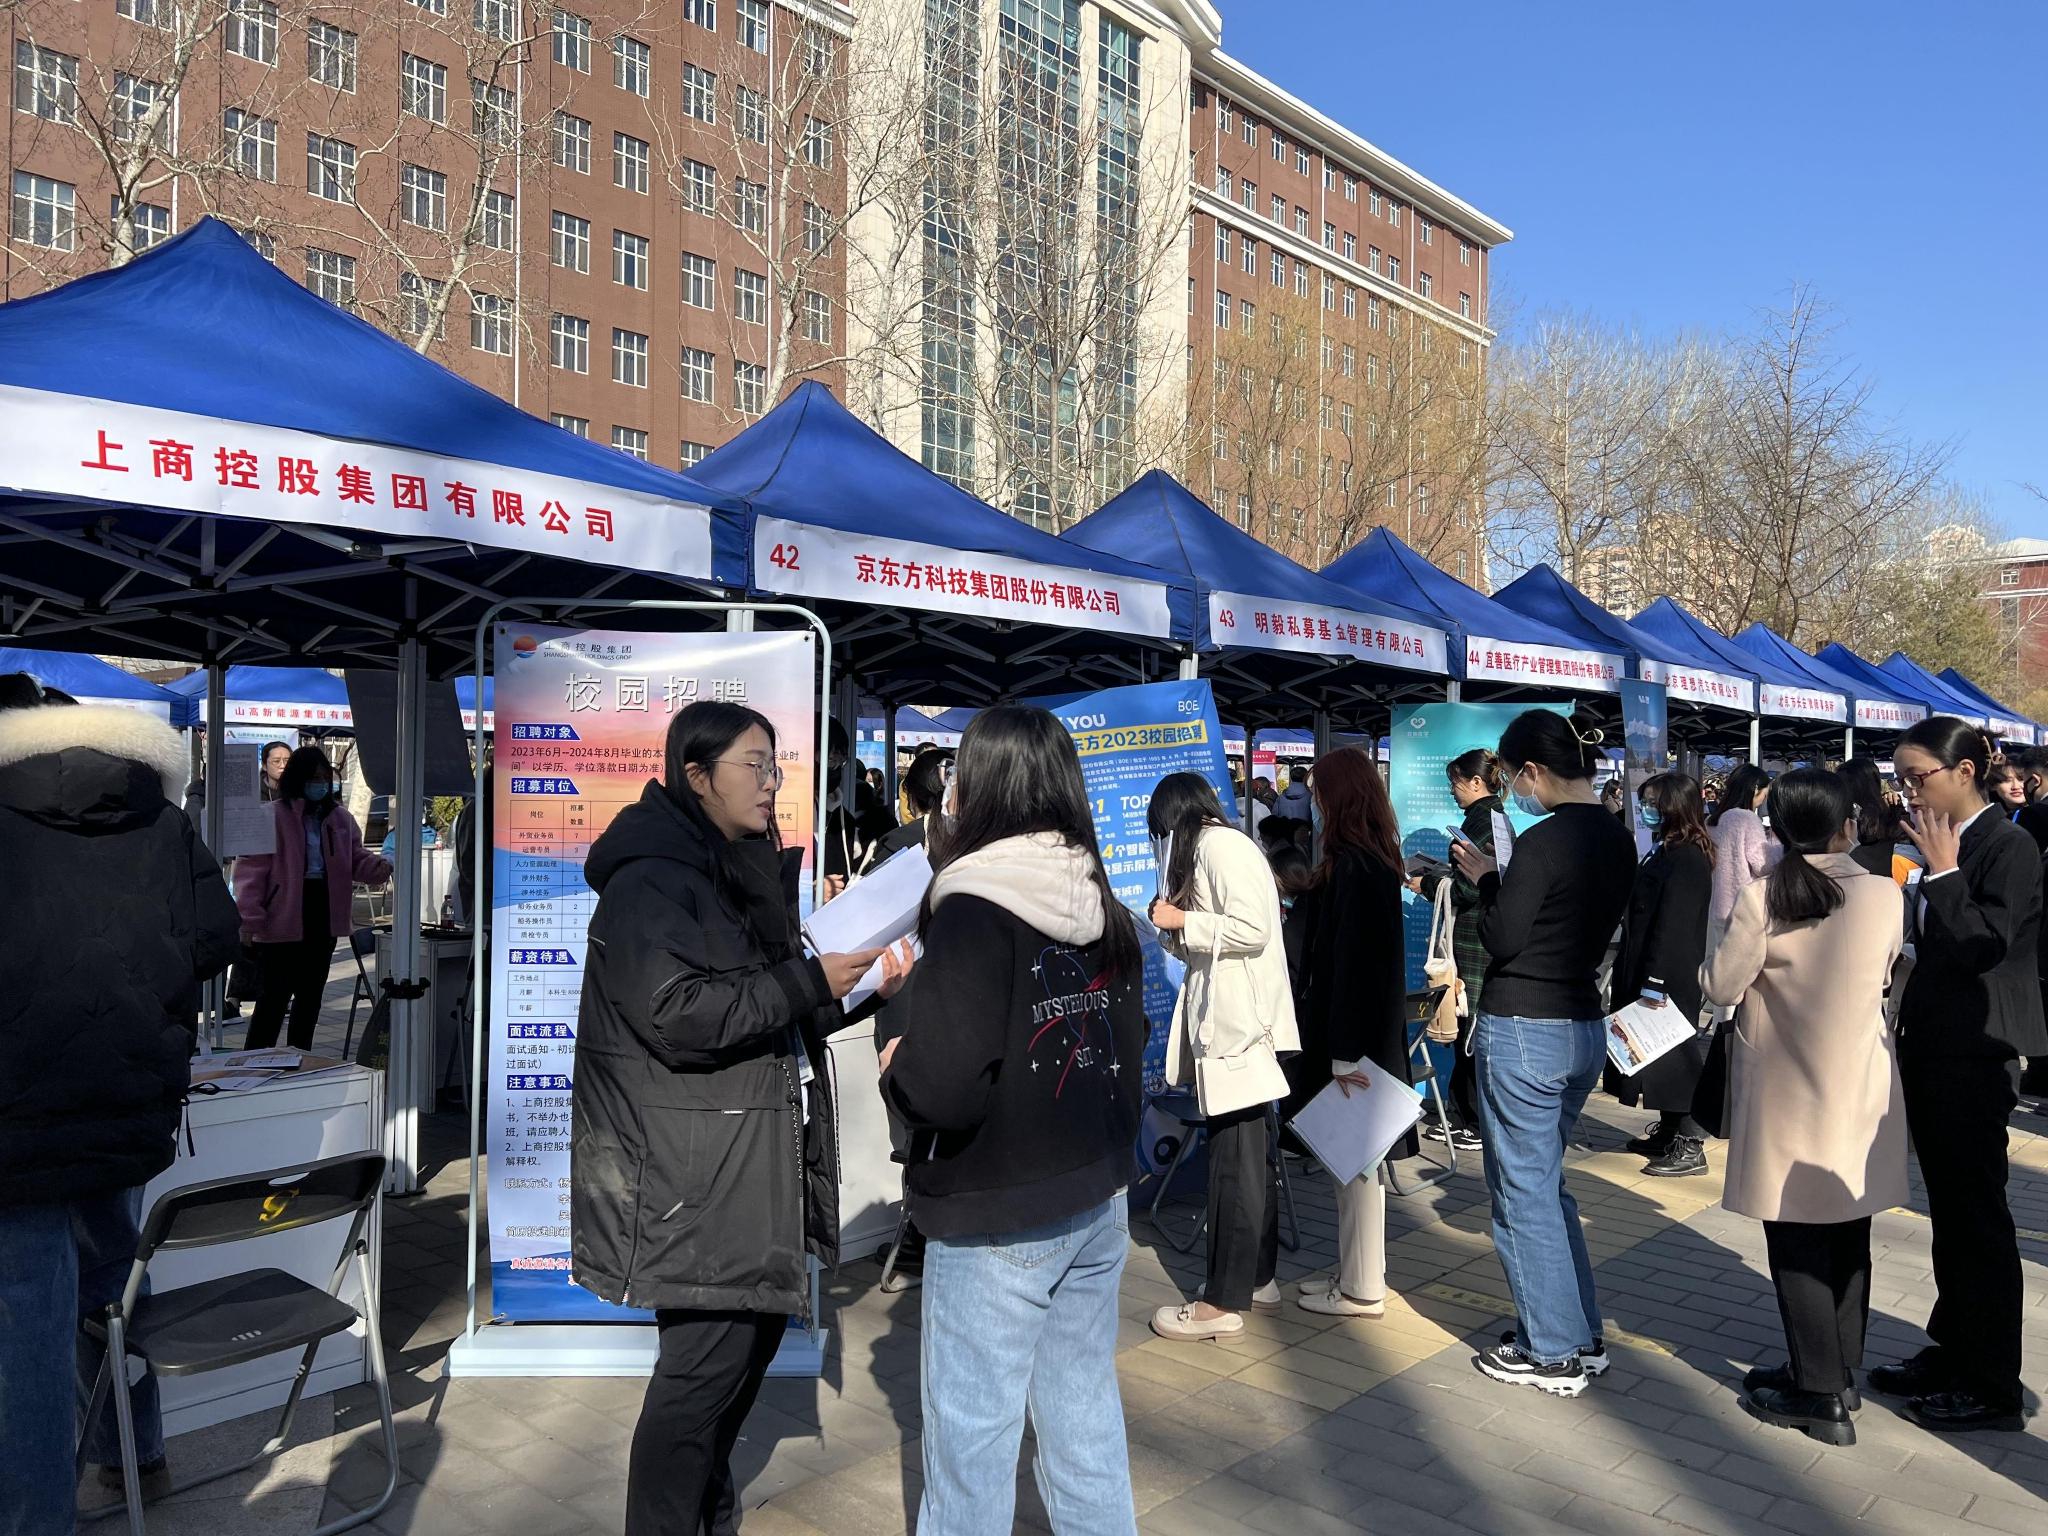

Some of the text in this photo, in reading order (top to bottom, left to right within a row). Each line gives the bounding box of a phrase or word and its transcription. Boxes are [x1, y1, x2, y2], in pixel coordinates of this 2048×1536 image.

[80, 430, 614, 542] 上商控股集团有限公司
[769, 543, 1120, 616] 42 京东方科技集团股份有限公司
[1219, 609, 1424, 658] 43 明毅私募基金管理有限公司
[1468, 650, 1480, 665] 44
[565, 672, 749, 714] 校园招聘
[1178, 700, 1200, 714] BOE
[1067, 713, 1107, 730] YOU
[513, 726, 572, 739] 招聘对象
[513, 780, 571, 793] 招募岗位
[1120, 795, 1151, 810] TOP
[530, 811, 544, 819] 岗位
[519, 831, 554, 839] 外贸业务员
[1102, 842, 1154, 859] 4个智能
[511, 950, 568, 963] 薪资待遇
[509, 1025, 567, 1037] 面试流程
[506, 1044, 549, 1055] 面试通知
[509, 1076, 567, 1089] 注意事项
[506, 1112, 572, 1122] 书，不举办也
